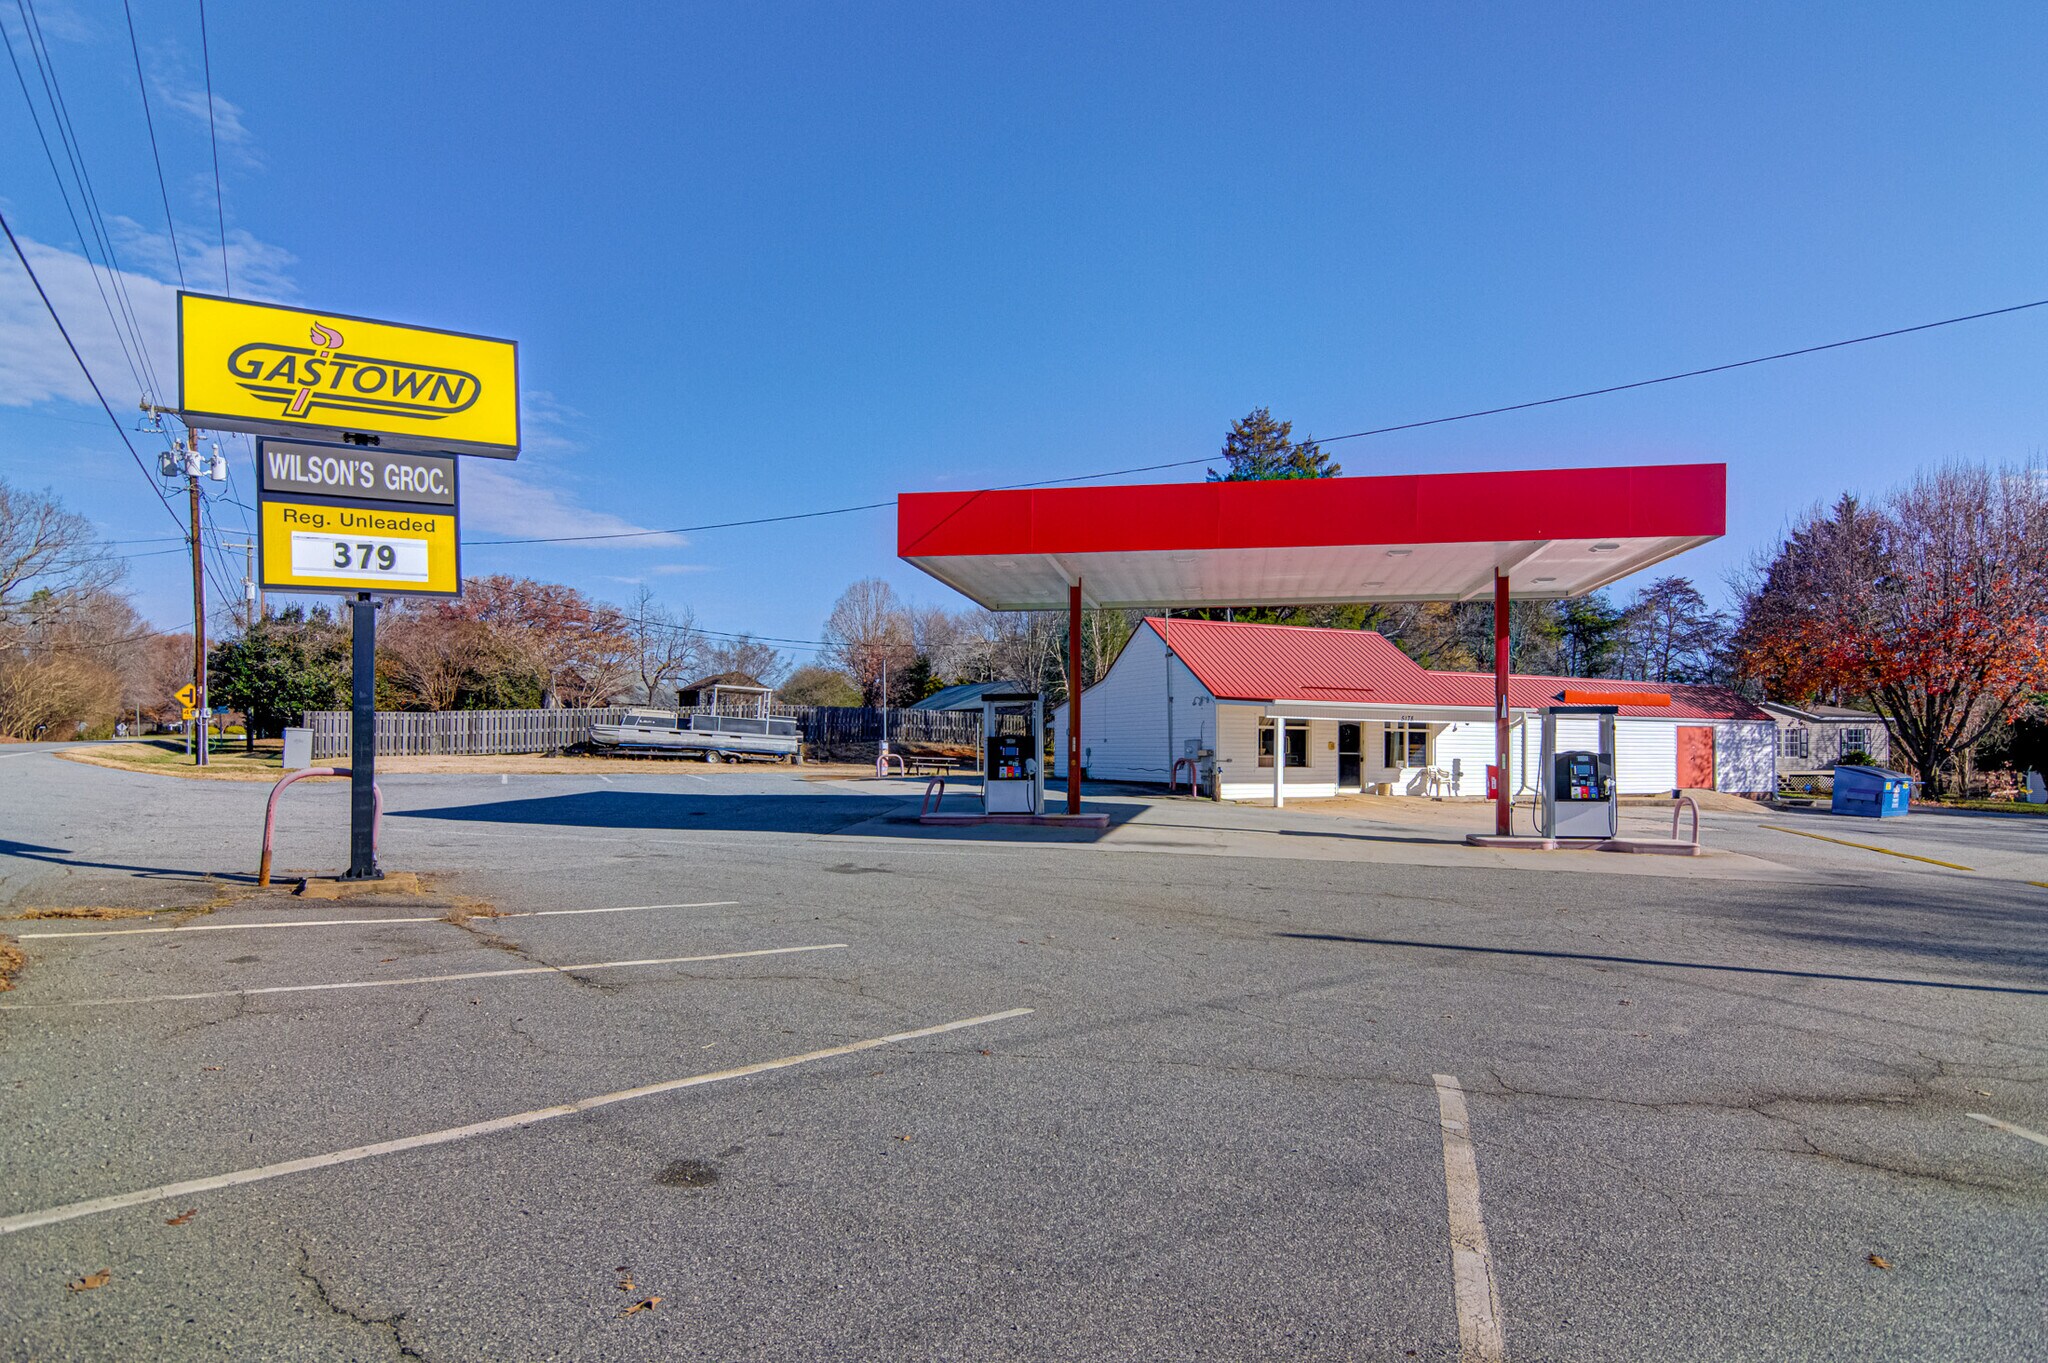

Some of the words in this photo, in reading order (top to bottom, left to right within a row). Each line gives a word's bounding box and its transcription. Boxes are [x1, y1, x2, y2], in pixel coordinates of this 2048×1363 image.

[228, 343, 470, 406] GASTOWN
[268, 452, 374, 488] WILSON'S
[384, 463, 449, 494] GROC.
[283, 508, 331, 528] Reg.
[340, 512, 435, 533] Unleaded
[334, 542, 396, 571] 379
